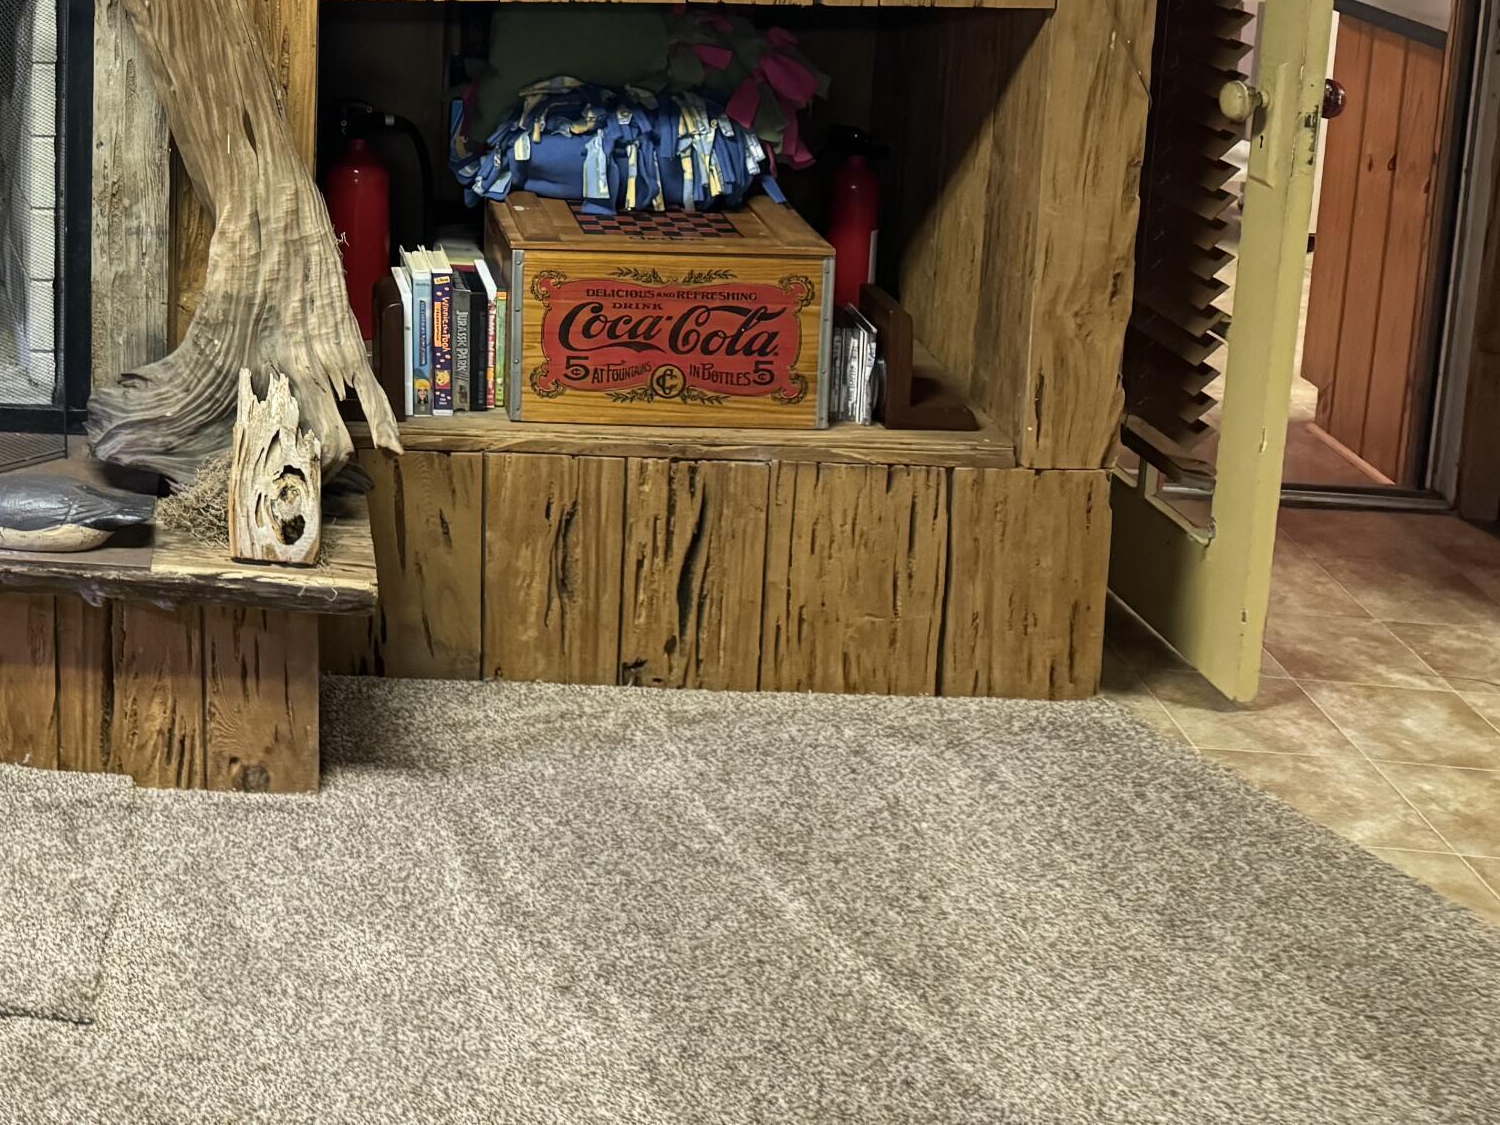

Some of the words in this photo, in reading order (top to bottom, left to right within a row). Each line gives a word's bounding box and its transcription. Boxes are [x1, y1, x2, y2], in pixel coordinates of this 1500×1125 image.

[586, 288, 655, 299] DELICIOUS
[676, 290, 757, 301] REFRESHING
[612, 302, 663, 311] DRINK
[456, 310, 469, 348] JURASSIC
[558, 301, 788, 357] Coca-Cola
[441, 333, 450, 352] Pooh
[456, 349, 469, 372] PARK
[592, 365, 605, 384] AT
[606, 360, 652, 382] FOUNTAINS
[689, 363, 701, 376] IN
[701, 362, 751, 386] BOTTLES
